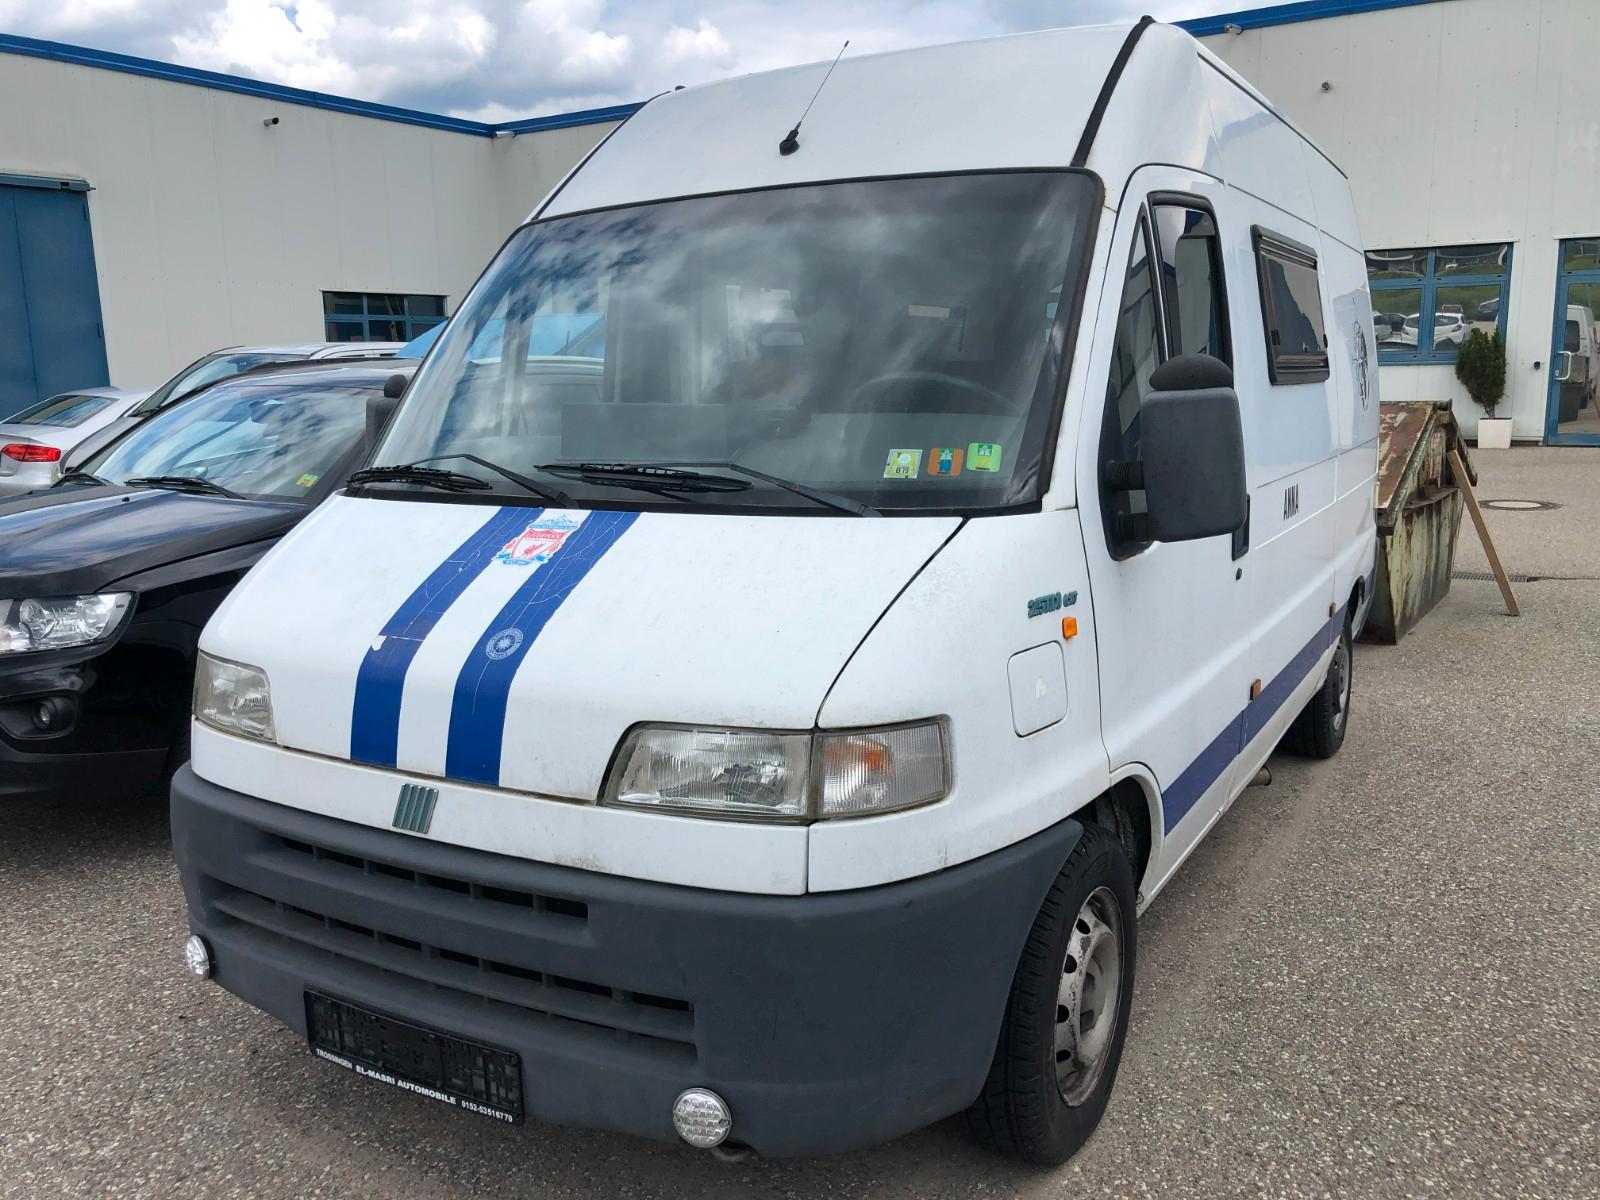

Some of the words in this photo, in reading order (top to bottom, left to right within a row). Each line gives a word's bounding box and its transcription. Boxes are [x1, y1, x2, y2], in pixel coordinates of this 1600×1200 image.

[316, 1048, 353, 1070] TROSSINGEN
[355, 1065, 396, 1085] EL-MASRI
[397, 1079, 457, 1105] AUTOMOBILE
[461, 1100, 514, 1123] 0152-53516770
